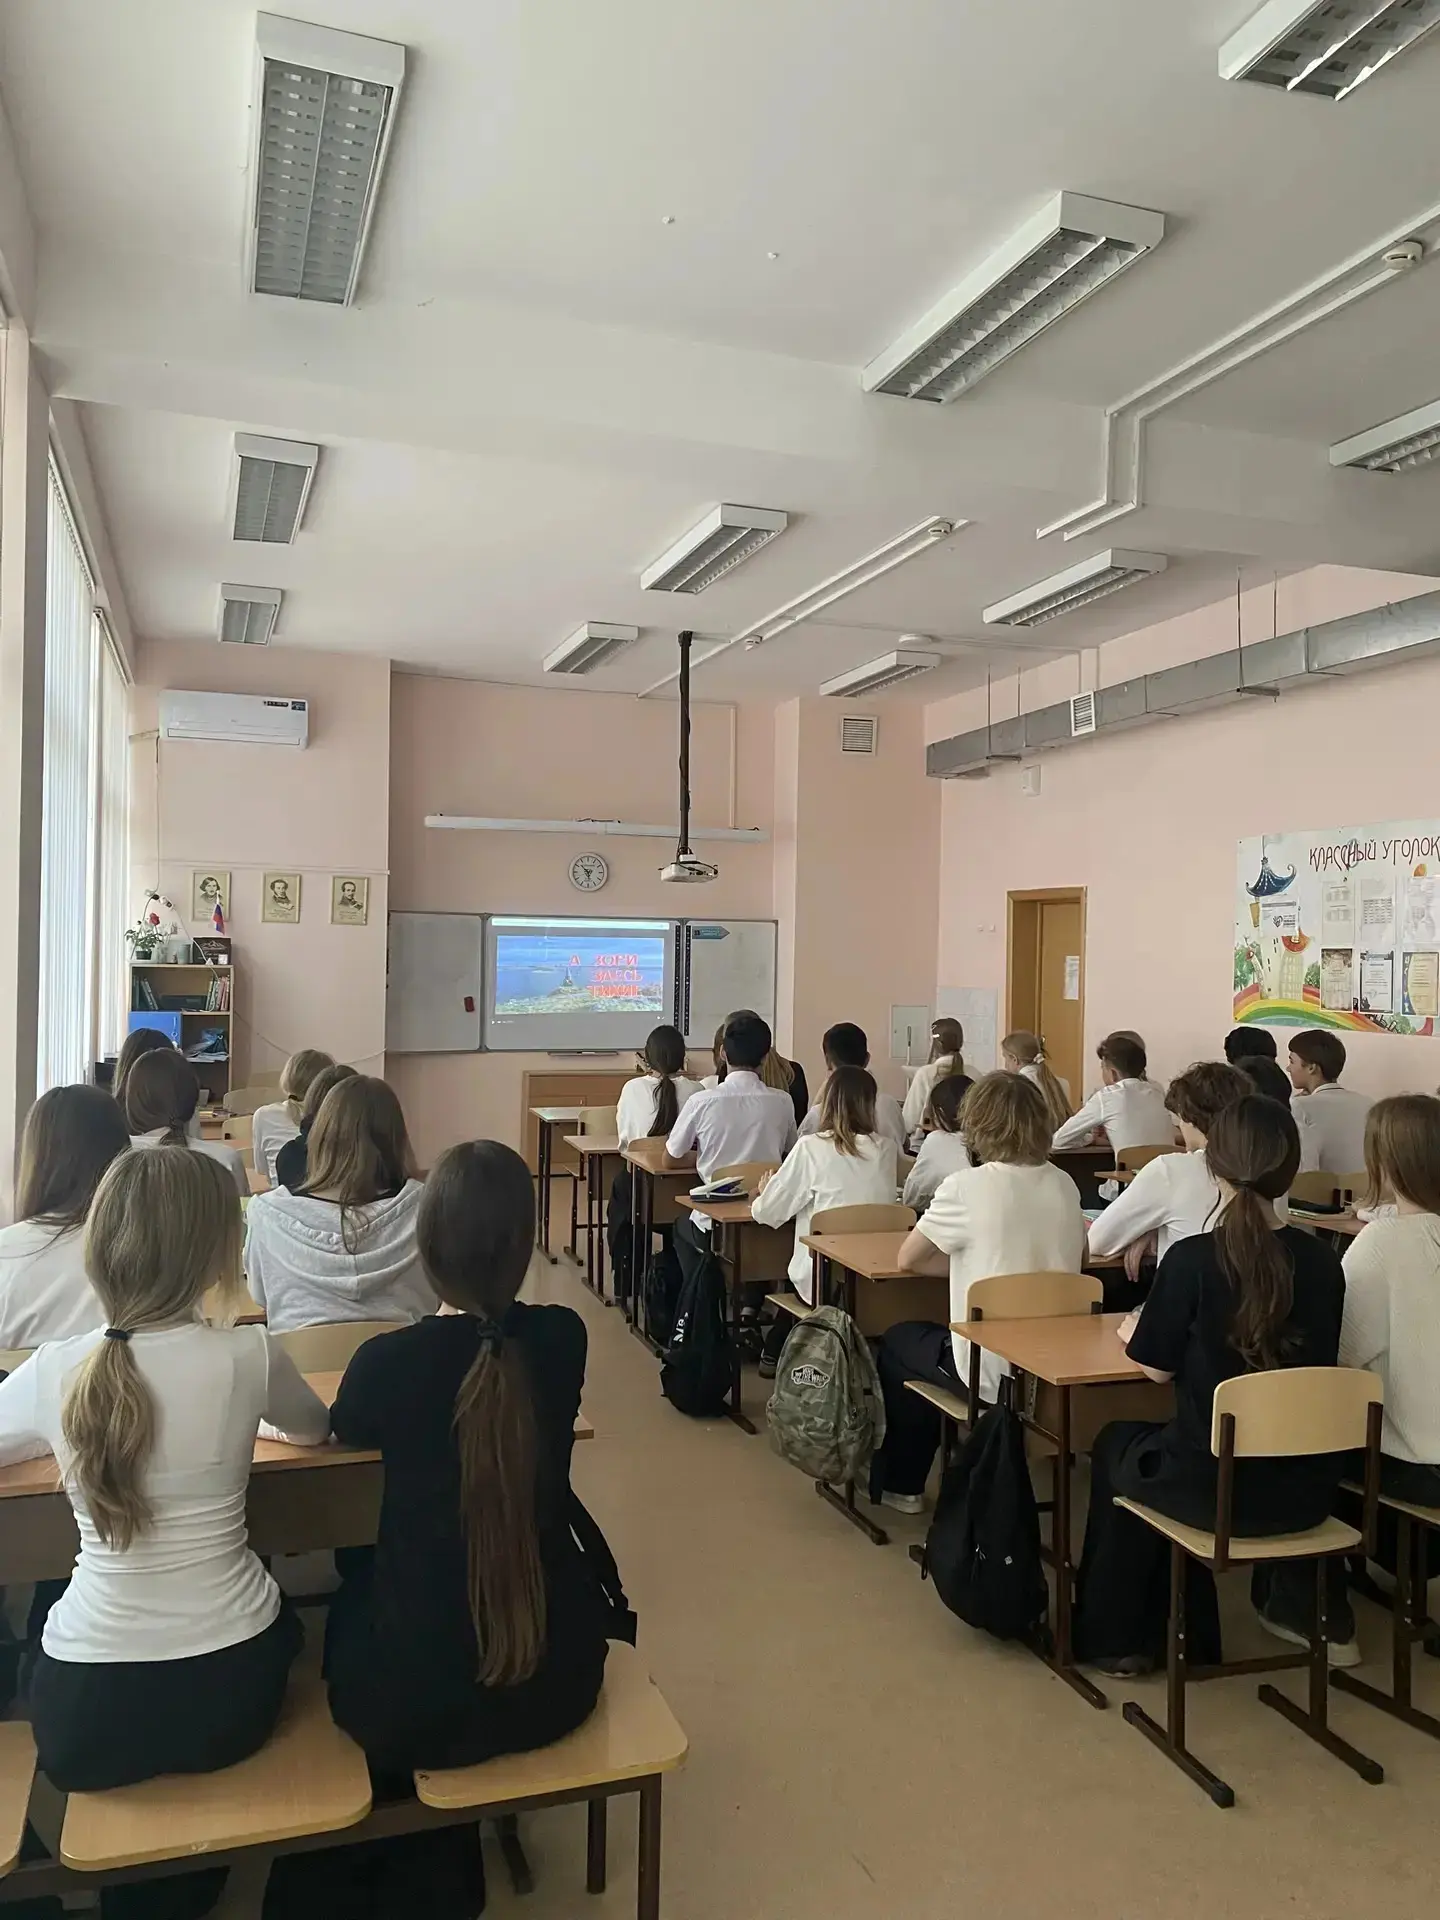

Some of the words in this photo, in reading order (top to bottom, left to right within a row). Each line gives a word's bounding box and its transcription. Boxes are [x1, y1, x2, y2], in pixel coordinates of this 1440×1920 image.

[1309, 838, 1377, 872] КЛАССНЫЙ
[1382, 836, 1440, 866] УГОЛОК
[569, 954, 581, 966] А
[595, 954, 638, 966] ЗОРИ
